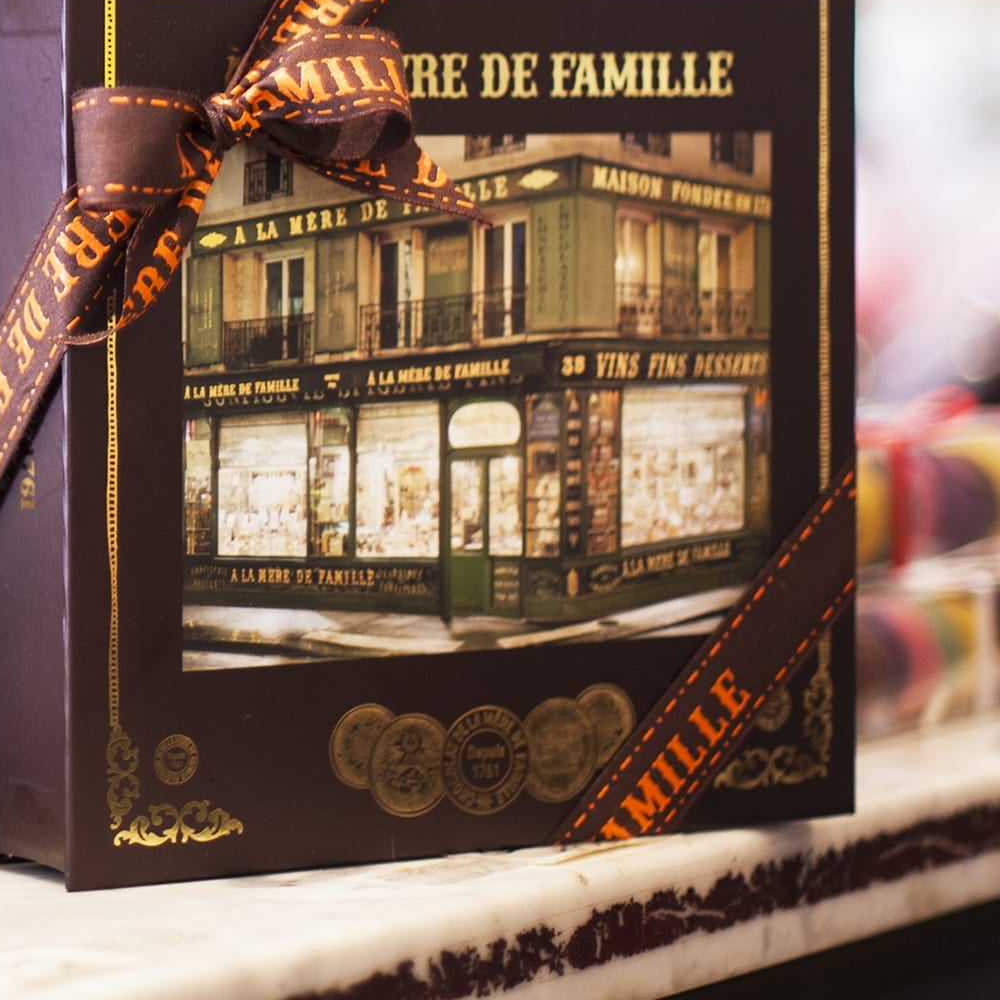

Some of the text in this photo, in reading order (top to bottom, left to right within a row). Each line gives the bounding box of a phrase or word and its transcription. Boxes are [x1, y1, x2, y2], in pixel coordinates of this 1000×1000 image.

[480, 52, 539, 99] DE
[550, 50, 735, 99] FAMILLE
[592, 165, 663, 199] MAISON
[256, 220, 279, 241] LA
[360, 199, 388, 222] DE
[7, 287, 50, 374] DE
[378, 370, 395, 386] LA
[434, 364, 452, 381] DE
[454, 358, 511, 379] FAMILLE
[596, 352, 641, 379] VINS
[647, 352, 689, 378] FINS
[193, 386, 206, 399] LA
[239, 382, 253, 396] DE
[254, 378, 300, 394] FAMILLE
[241, 567, 256, 584] LA
[296, 568, 313, 585] DE
[318, 568, 376, 587] FAMILLE
